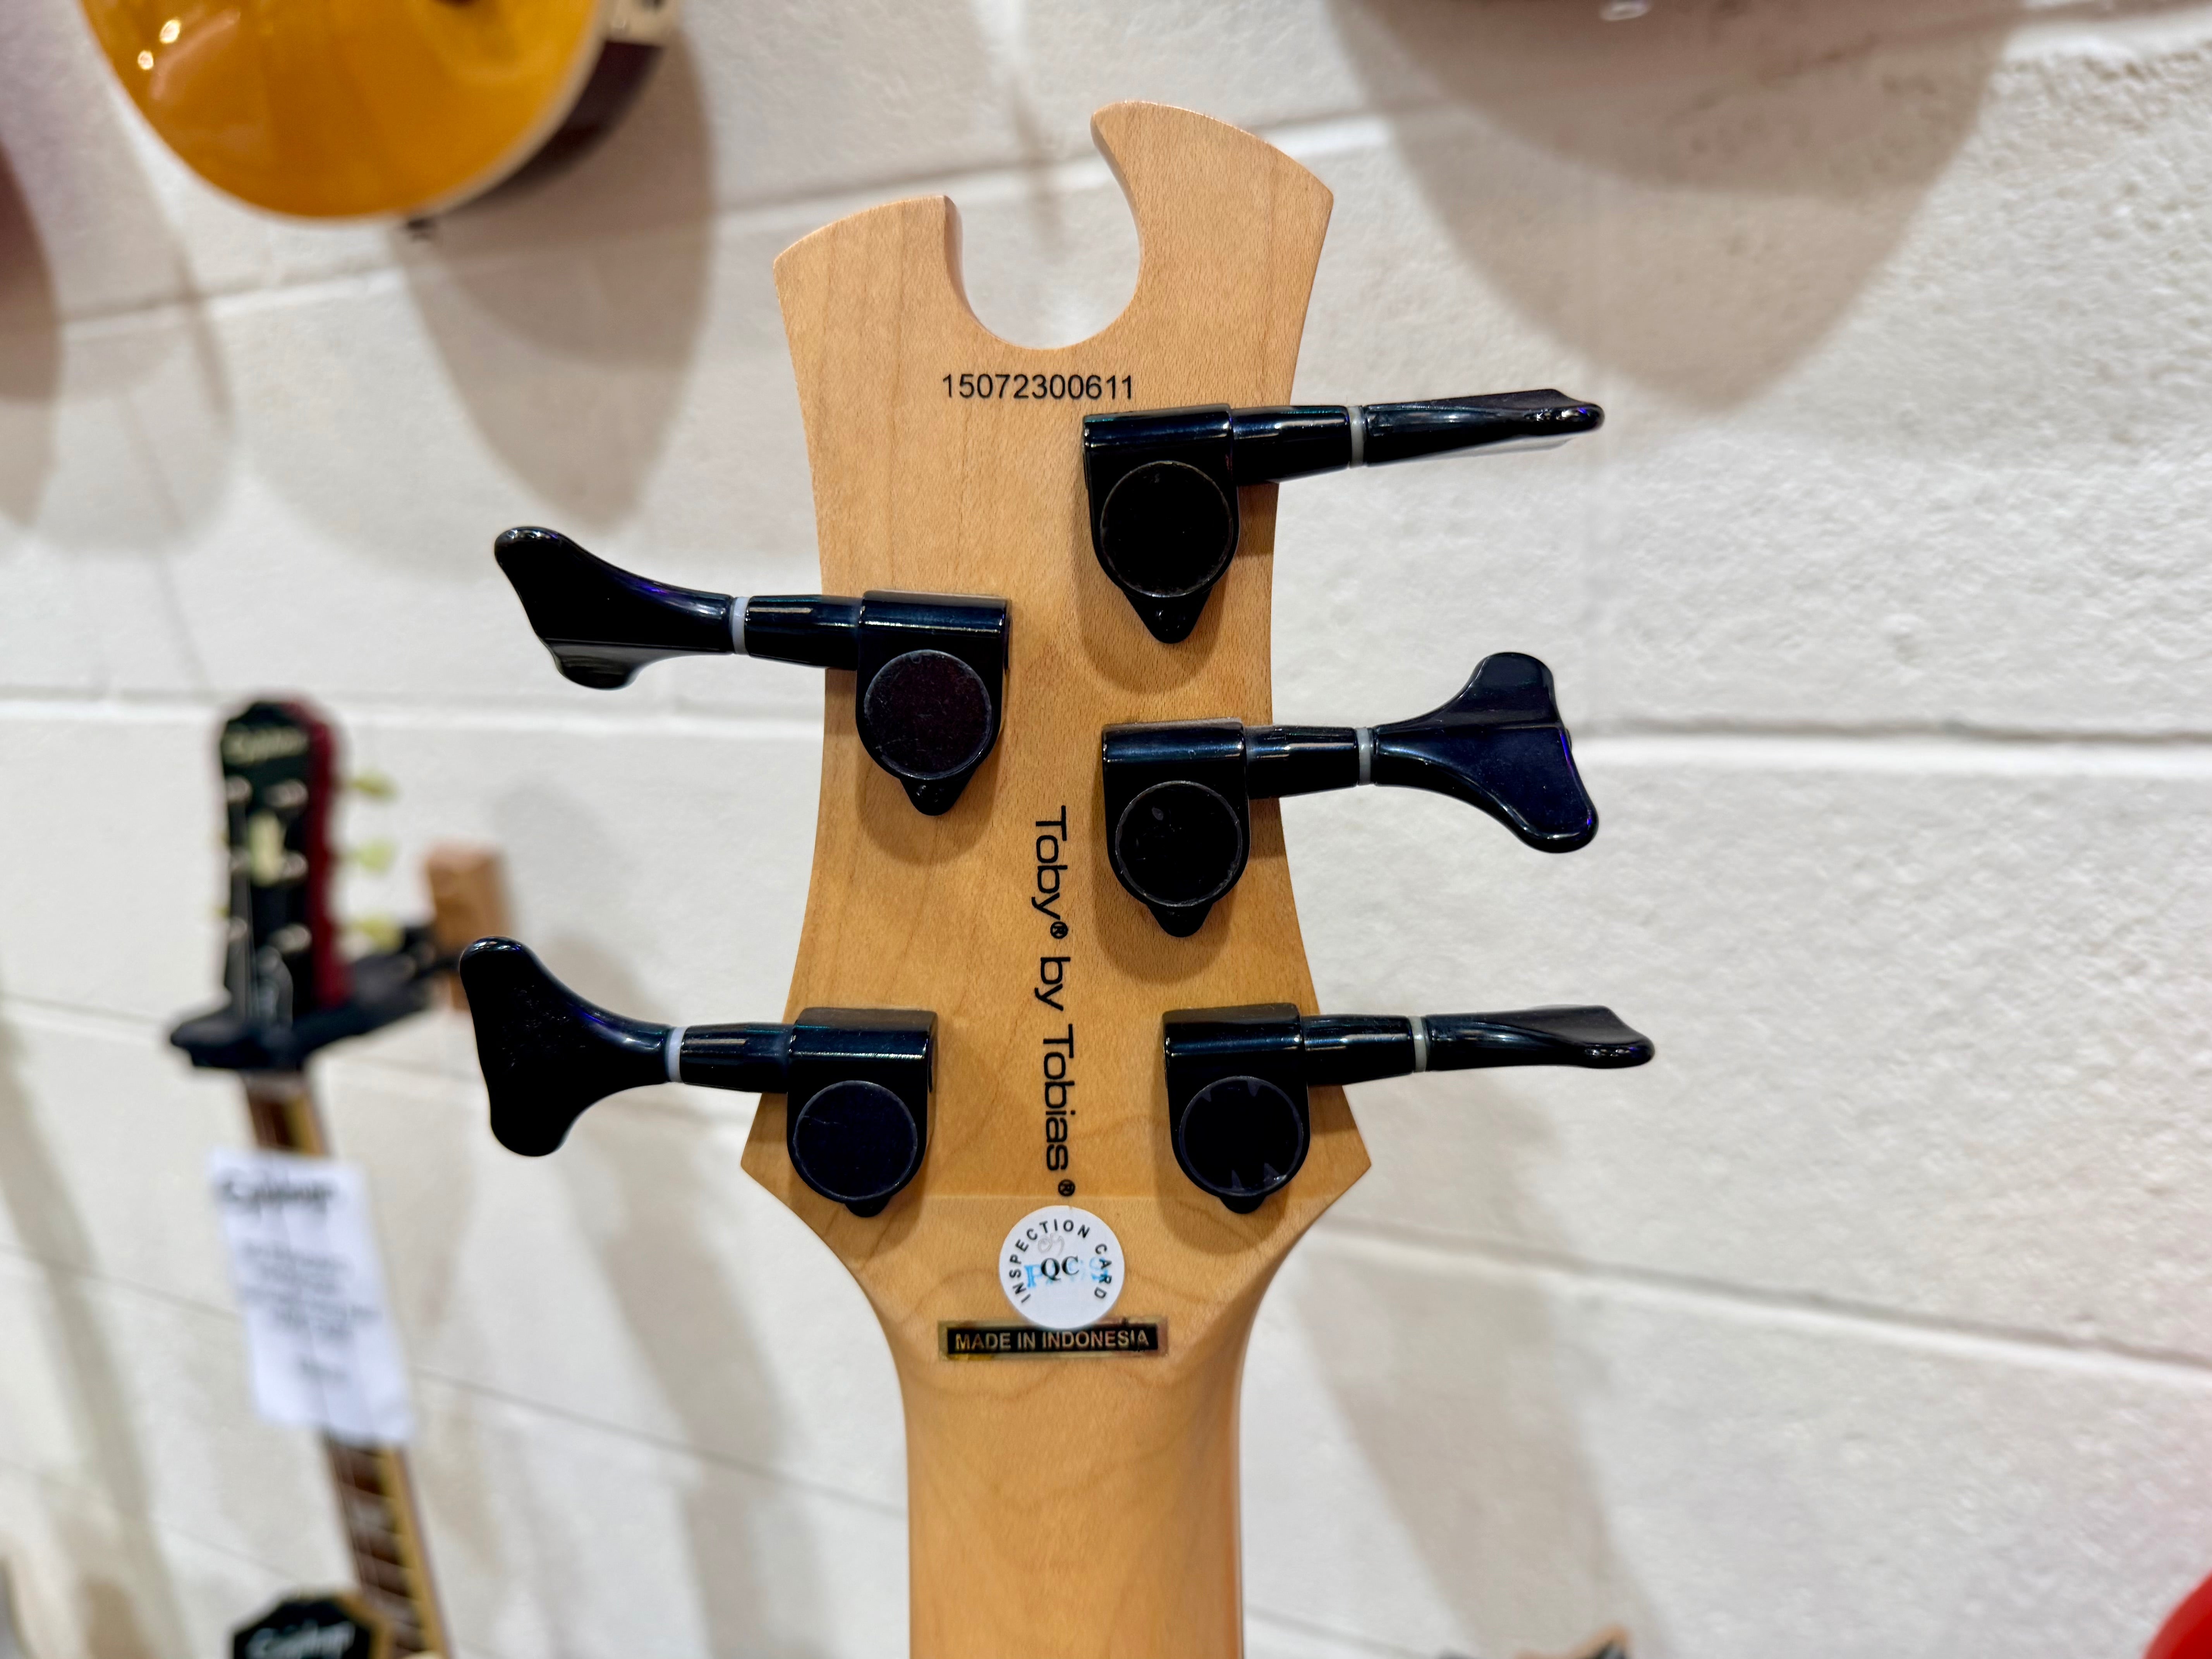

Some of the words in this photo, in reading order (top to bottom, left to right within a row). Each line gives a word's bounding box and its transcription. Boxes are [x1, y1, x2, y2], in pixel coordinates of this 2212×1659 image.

[943, 373, 1132, 400] 15072300611
[1034, 957, 1071, 1012] by
[1009, 1218, 1090, 1304] INSPECTION
[1094, 1243, 1112, 1299] CARD
[1040, 1255, 1080, 1281] QC
[955, 1332, 1011, 1351] MADE
[1017, 1332, 1036, 1350] IN
[1042, 1329, 1149, 1349] INDONESIA
